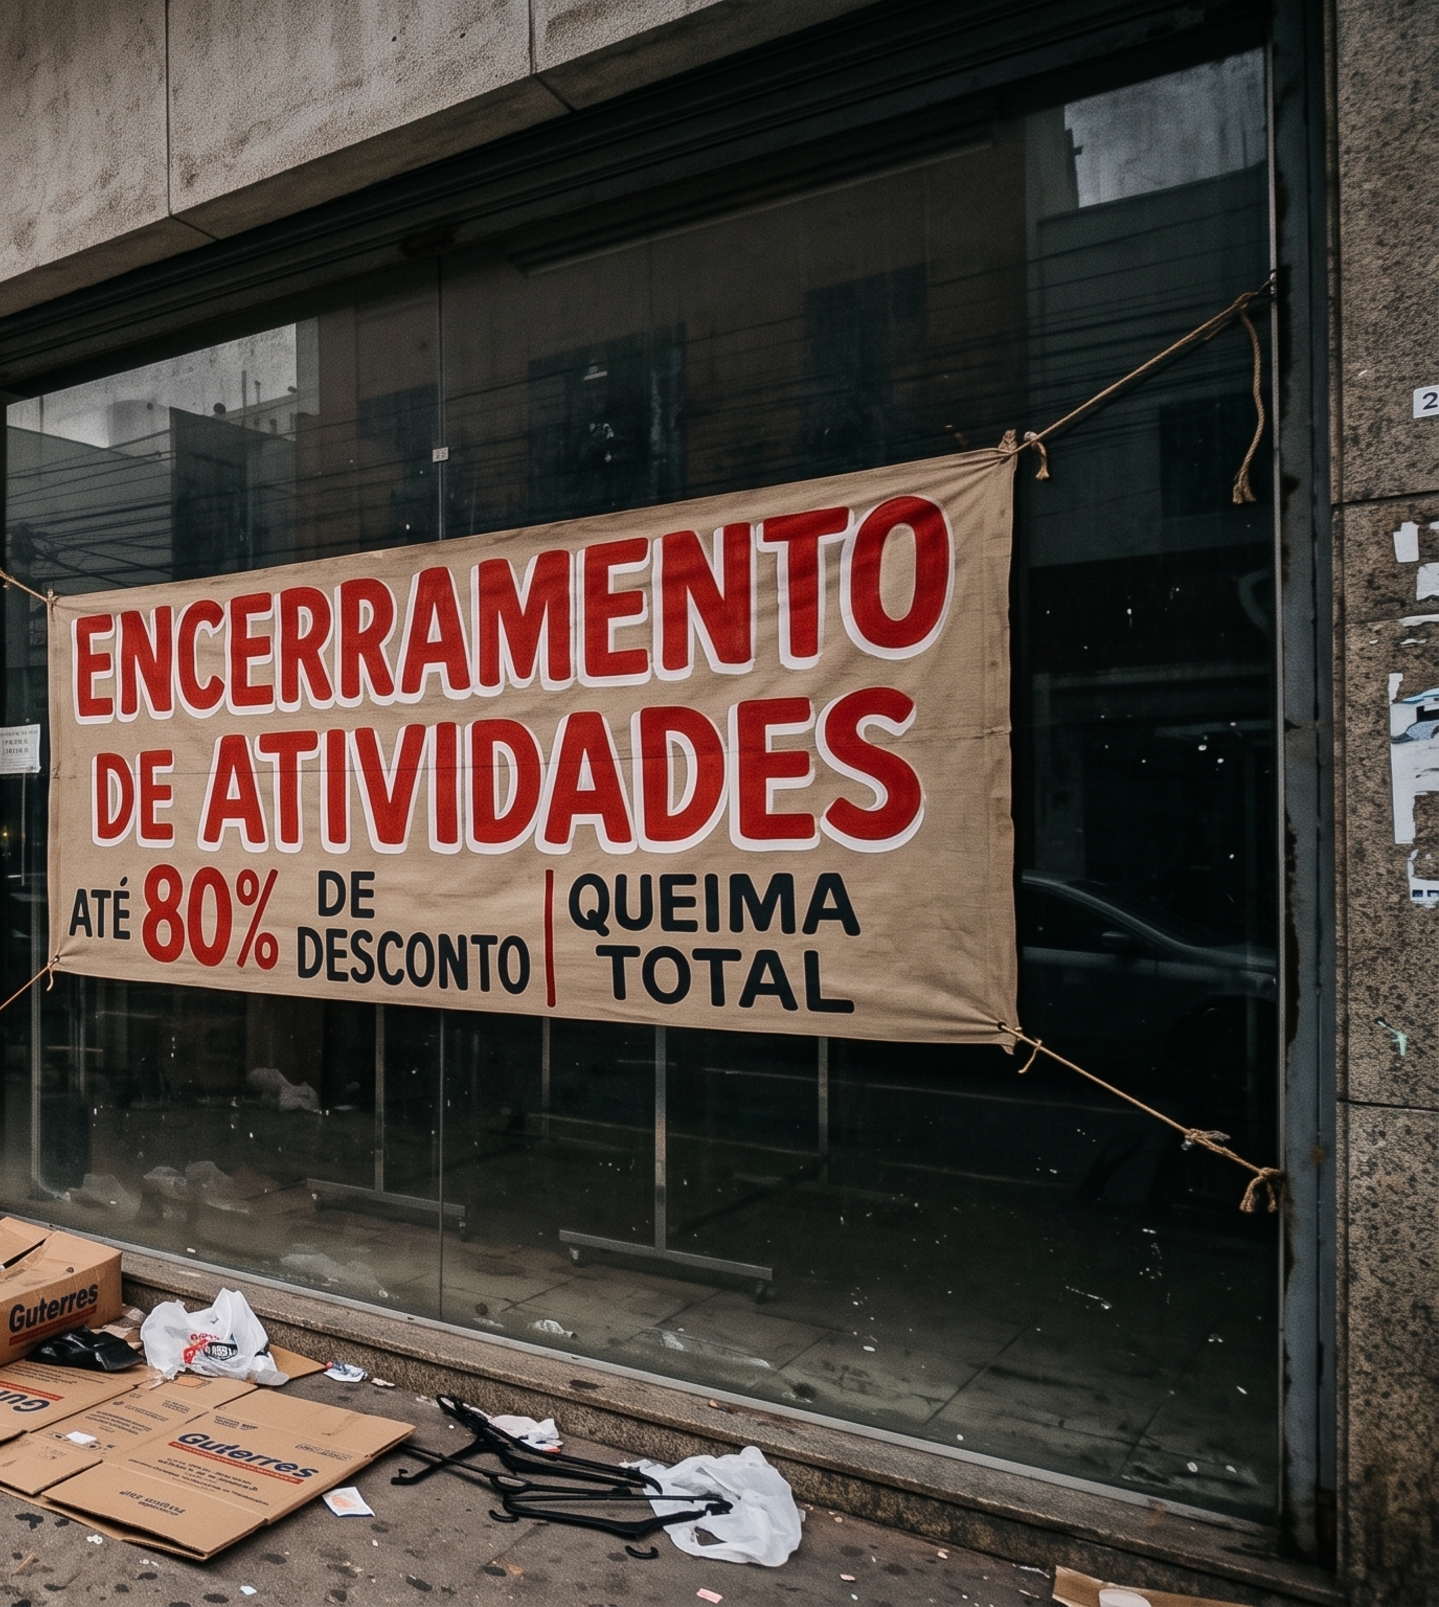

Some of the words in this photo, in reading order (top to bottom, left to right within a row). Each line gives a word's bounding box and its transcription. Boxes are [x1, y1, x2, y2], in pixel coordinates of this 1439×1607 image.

[72, 495, 955, 724] ENCERRAMENTO
[92, 748, 175, 848] DE
[197, 686, 925, 854] ATIVIDADES
[68, 875, 131, 940] ATÉ
[141, 863, 280, 970] 80%
[317, 870, 375, 918] DE
[568, 872, 861, 936] QUEIMA
[297, 926, 530, 995] DESCONTO
[595, 945, 855, 1014] TOTAL
[9, 1283, 99, 1333] Guterres
[177, 1432, 320, 1479] Guterres
